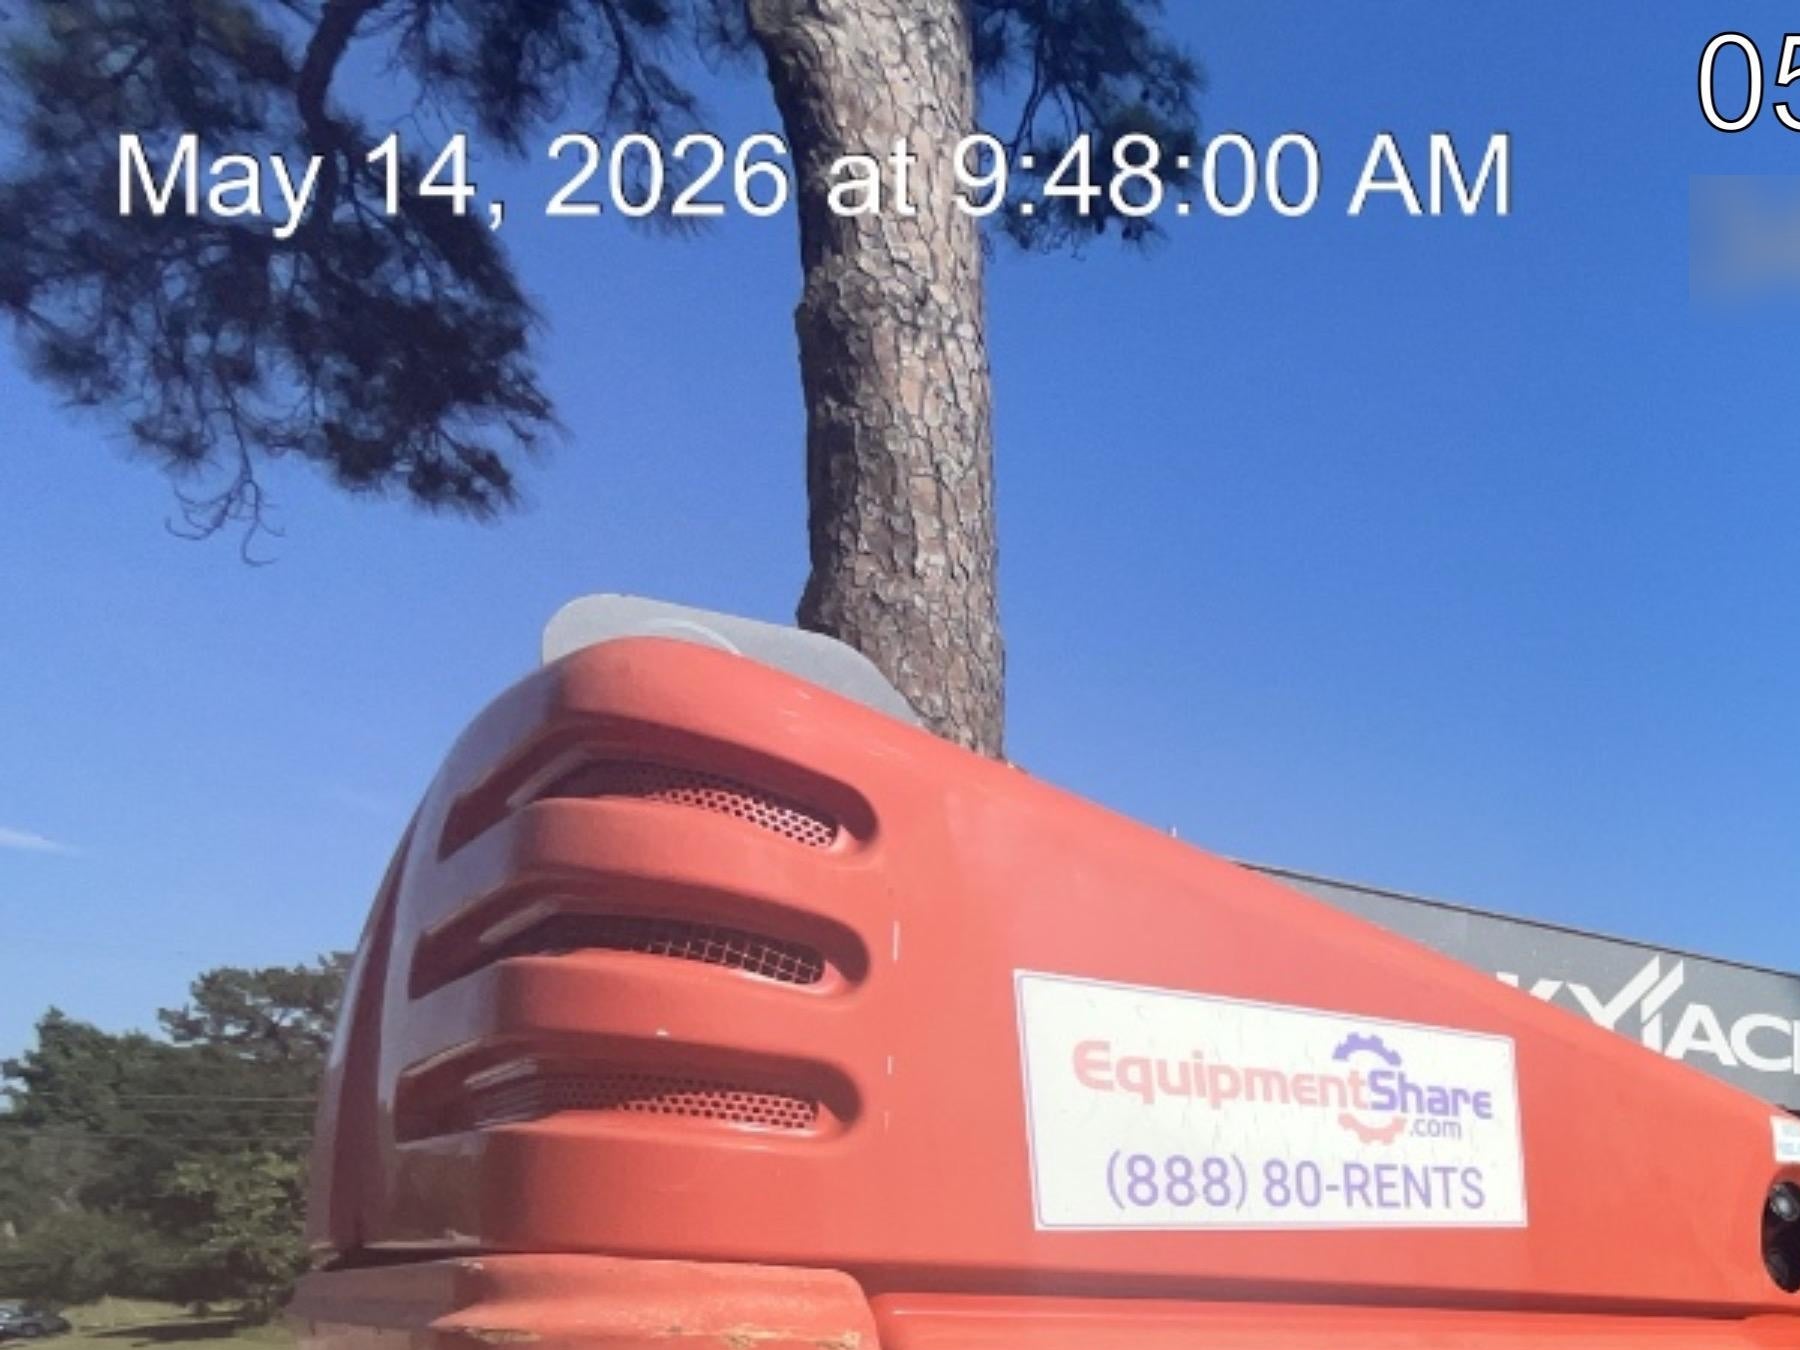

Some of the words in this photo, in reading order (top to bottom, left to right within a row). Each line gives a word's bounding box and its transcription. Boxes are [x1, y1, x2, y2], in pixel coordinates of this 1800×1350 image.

[1072, 1038, 1494, 1120] EquipmentShare
[1105, 1150, 1247, 1211] (888)
[1263, 1158, 1486, 1210] 80-RENTS
